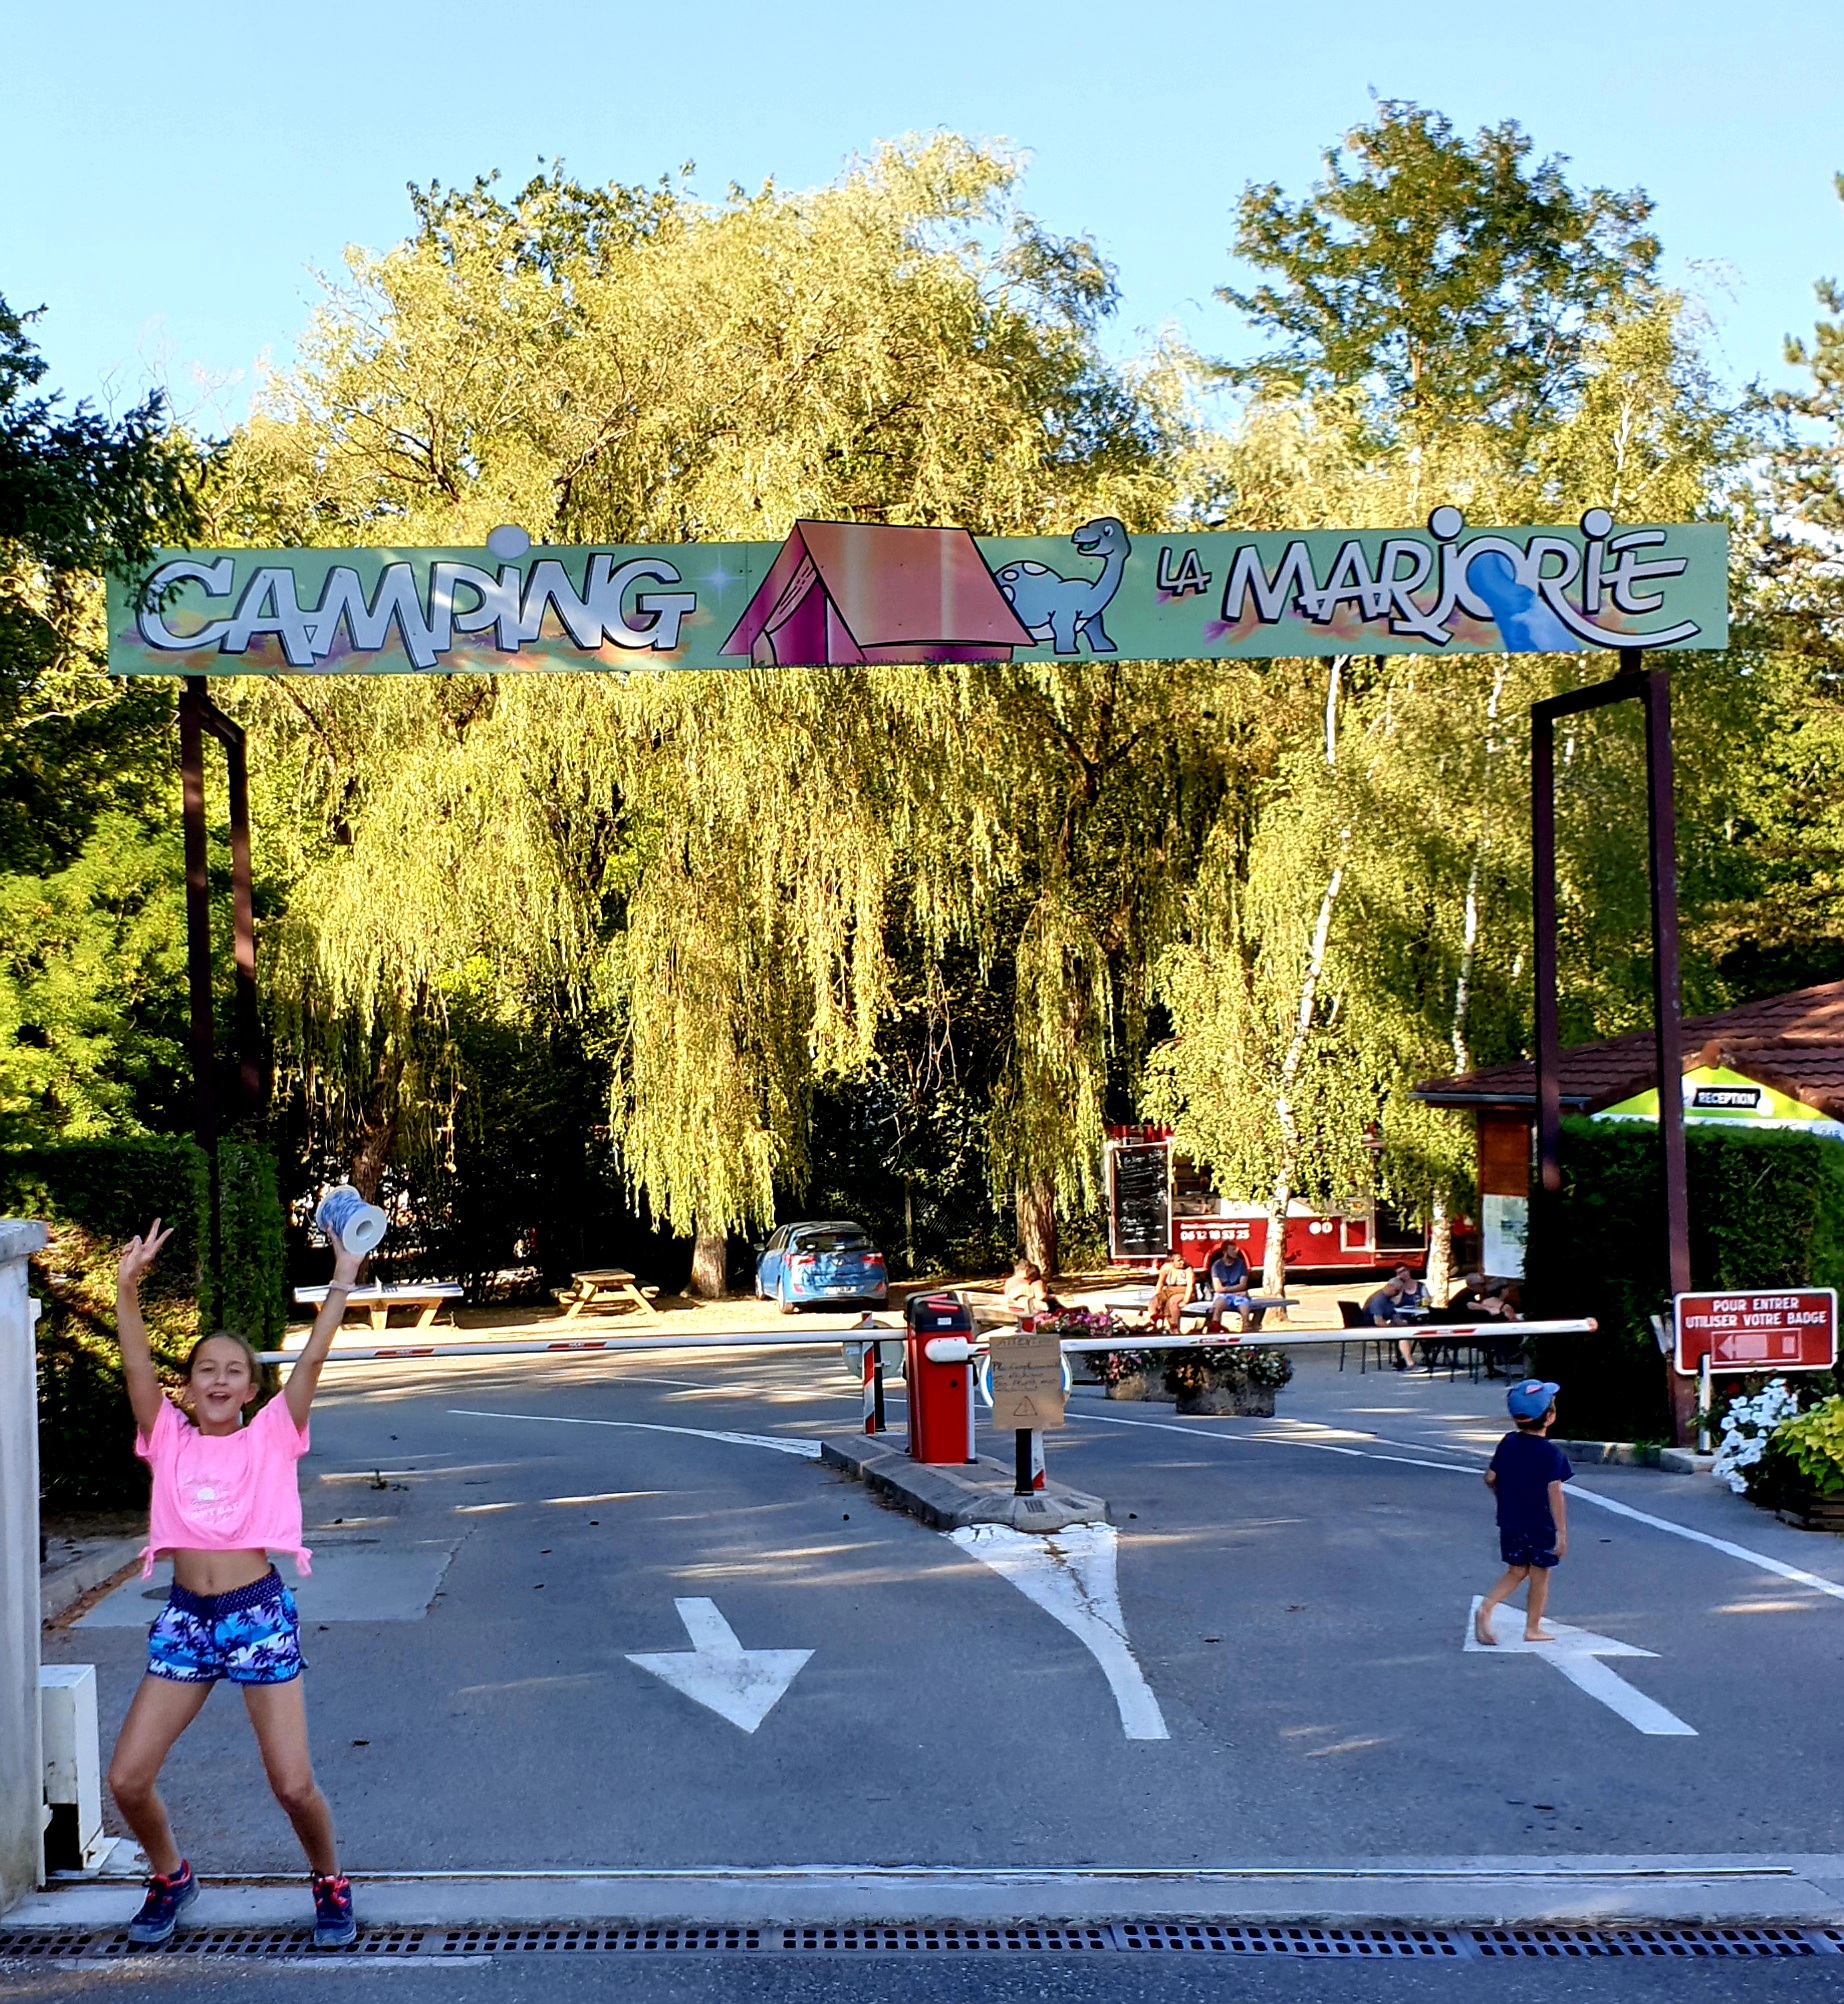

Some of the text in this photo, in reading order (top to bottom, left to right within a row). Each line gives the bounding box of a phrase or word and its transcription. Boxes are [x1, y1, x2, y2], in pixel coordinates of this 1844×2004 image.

[136, 505, 1701, 670] CAMPING LA MARJORIE
[1196, 1230, 1208, 1241] 12
[1713, 1297, 1799, 1312] POUR ENTRER
[1685, 1310, 1827, 1329] UTILISER VOTRE BADGE
